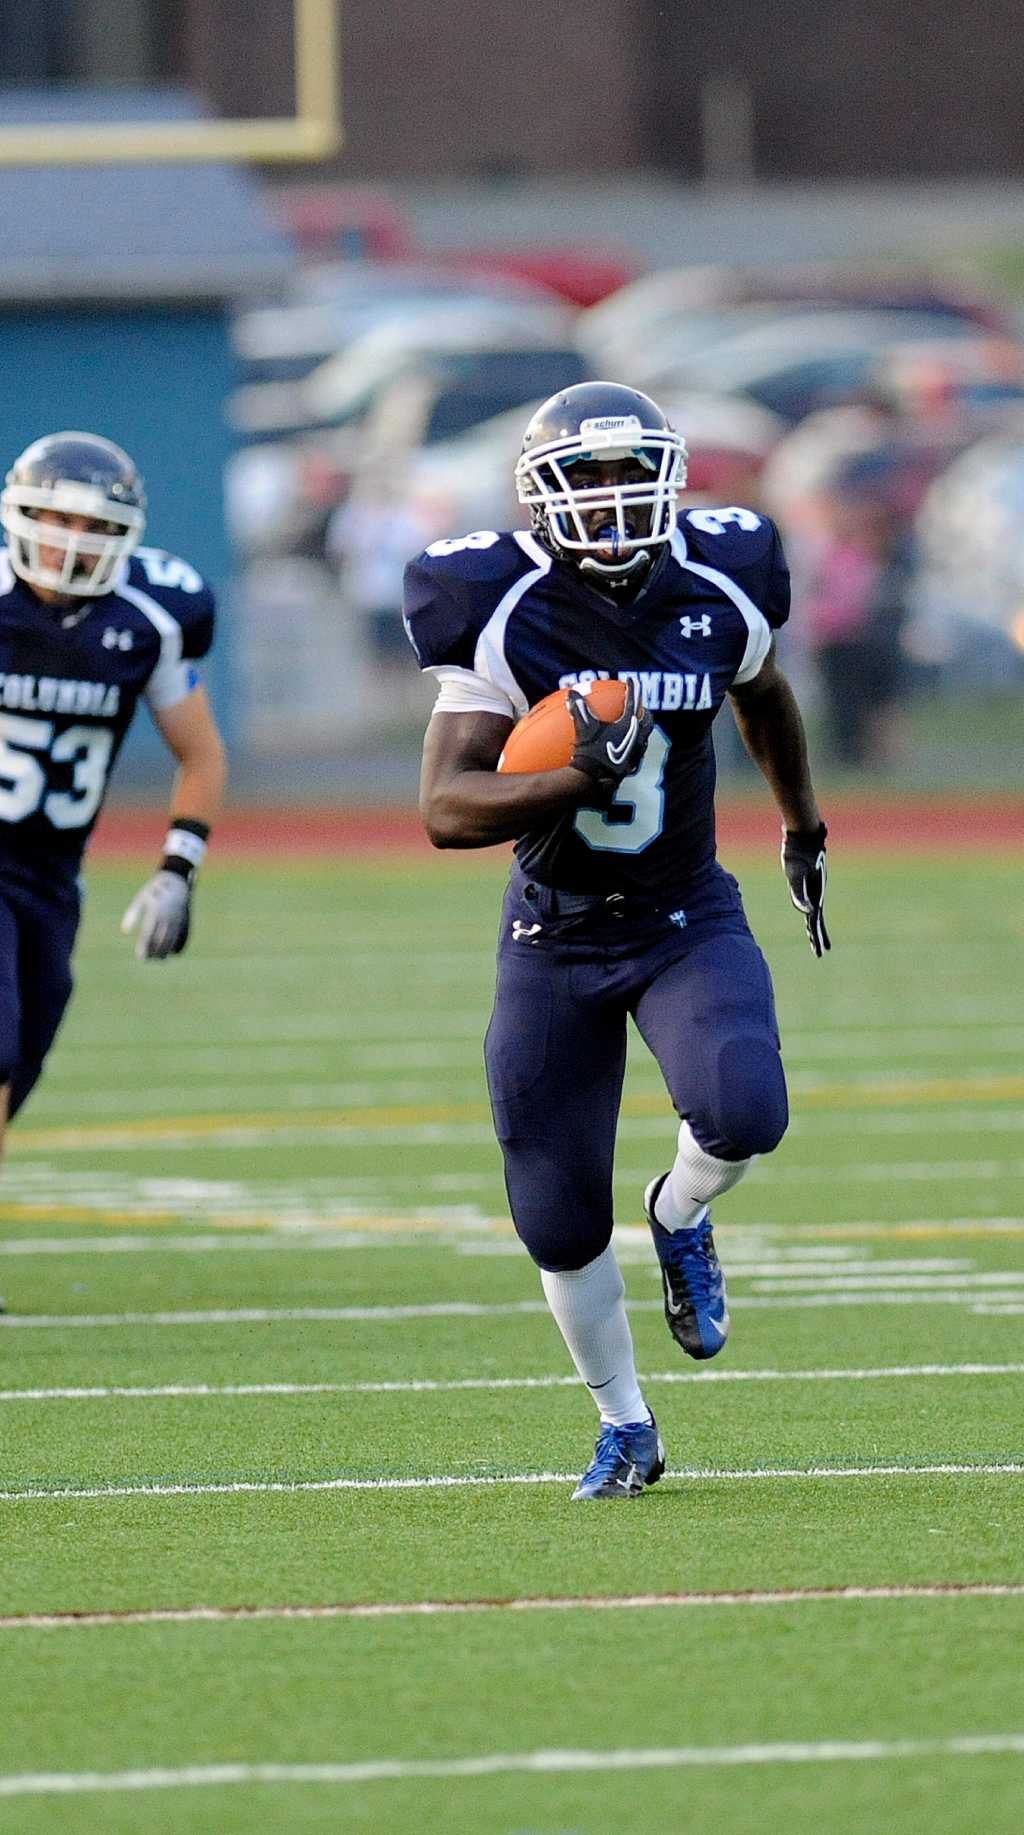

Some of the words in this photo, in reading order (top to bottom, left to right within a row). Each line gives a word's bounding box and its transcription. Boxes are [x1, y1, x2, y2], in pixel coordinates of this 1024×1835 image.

[686, 507, 762, 534] 3
[134, 549, 204, 594] 5
[559, 670, 713, 711] MBIA
[573, 722, 672, 854] 3
